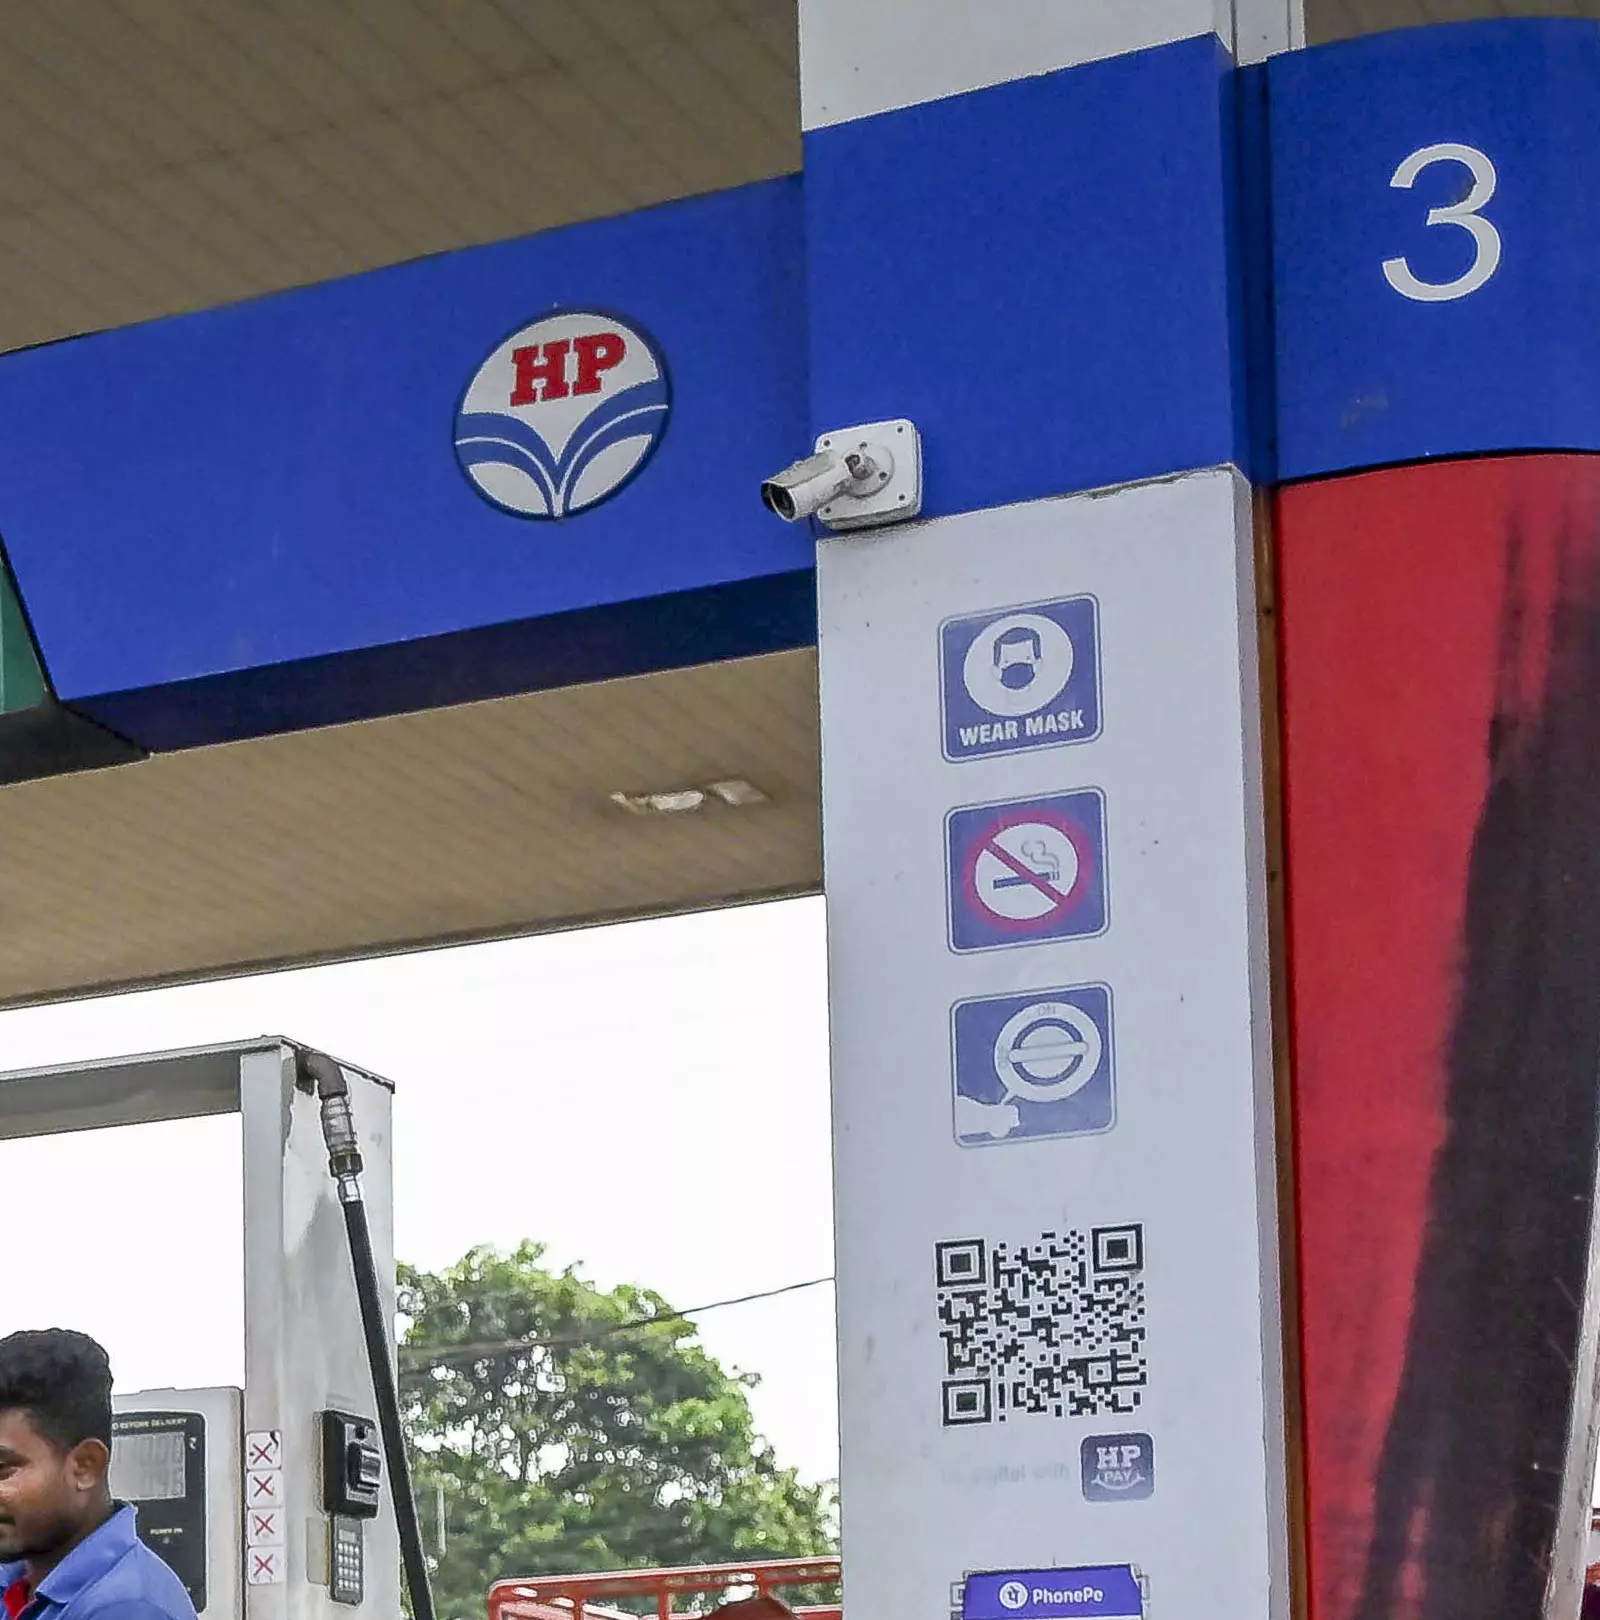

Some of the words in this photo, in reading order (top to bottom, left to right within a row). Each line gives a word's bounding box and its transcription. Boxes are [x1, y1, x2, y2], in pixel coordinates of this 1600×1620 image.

[1382, 142, 1501, 301] 3
[509, 333, 626, 406] HP
[959, 720, 1019, 747] WEAR
[1025, 709, 1084, 736] MASK
[1096, 1444, 1142, 1470] HP
[1032, 1586, 1104, 1605] PhonePe
